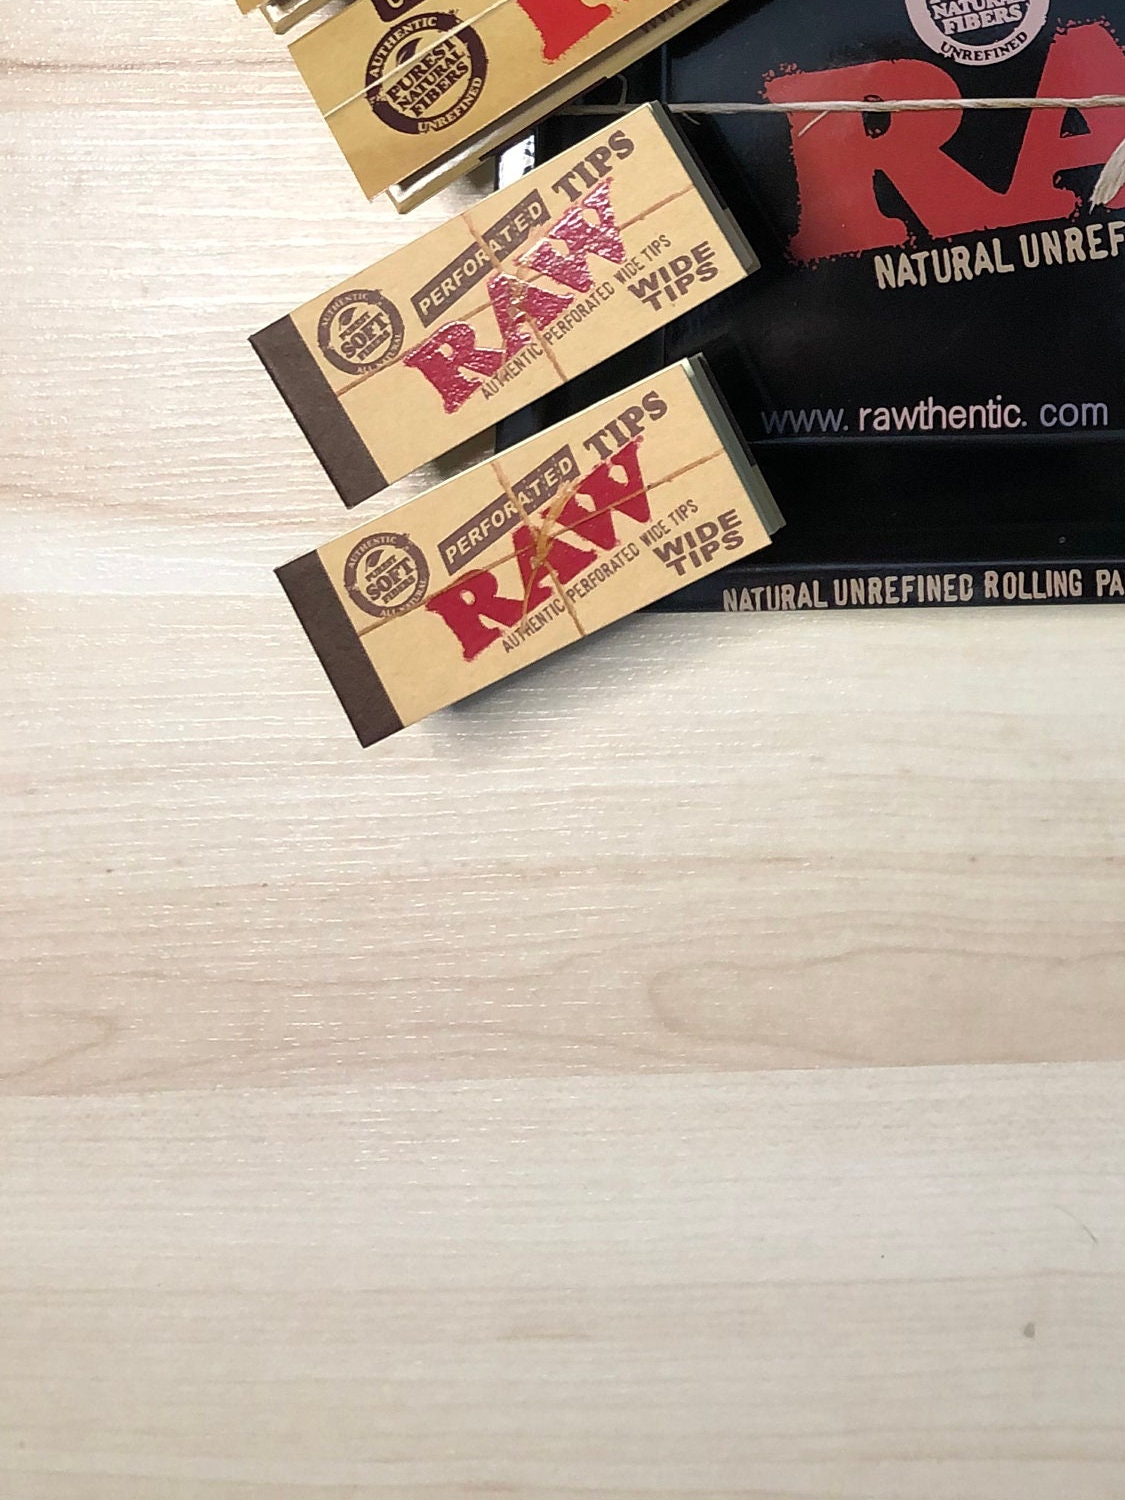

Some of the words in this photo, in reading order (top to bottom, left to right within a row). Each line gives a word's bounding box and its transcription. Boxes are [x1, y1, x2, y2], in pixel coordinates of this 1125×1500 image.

[369, 15, 439, 79] AUTHENTIC
[939, 31, 1028, 62] UNREFINED
[942, 4, 1023, 35] FIBERS
[385, 36, 457, 102] PUREST
[397, 50, 466, 112] NATURAL
[409, 60, 469, 118] FIBERS
[417, 76, 483, 133] UNREFINED
[418, 201, 543, 317] PERFORATED
[551, 129, 635, 203] TIPS
[627, 240, 717, 300] WIDE
[641, 261, 719, 313] TIPS
[873, 237, 1015, 290] NATURAL
[401, 176, 627, 415] RAW
[480, 342, 544, 401] AUTHENTIC
[545, 281, 616, 346] PERFORATED
[613, 257, 645, 286] WIDE
[644, 234, 672, 262] TIPS
[340, 312, 389, 359] SOFT
[443, 456, 574, 565] PERFORATED
[583, 390, 668, 462] TIPS
[348, 536, 397, 568] AUTHENTIC
[424, 434, 652, 663] RAW
[651, 508, 743, 564] WIDE
[665, 529, 745, 577] TIPS
[366, 556, 415, 601] SOFT
[501, 598, 566, 654] AUTHENTIC
[566, 541, 641, 604] PERFORATED
[639, 520, 670, 548] WIDE
[670, 498, 700, 527] TIPS
[722, 579, 828, 612] NATURAL
[833, 573, 974, 606] UNREFINED
[984, 569, 1083, 600] ROLLING
